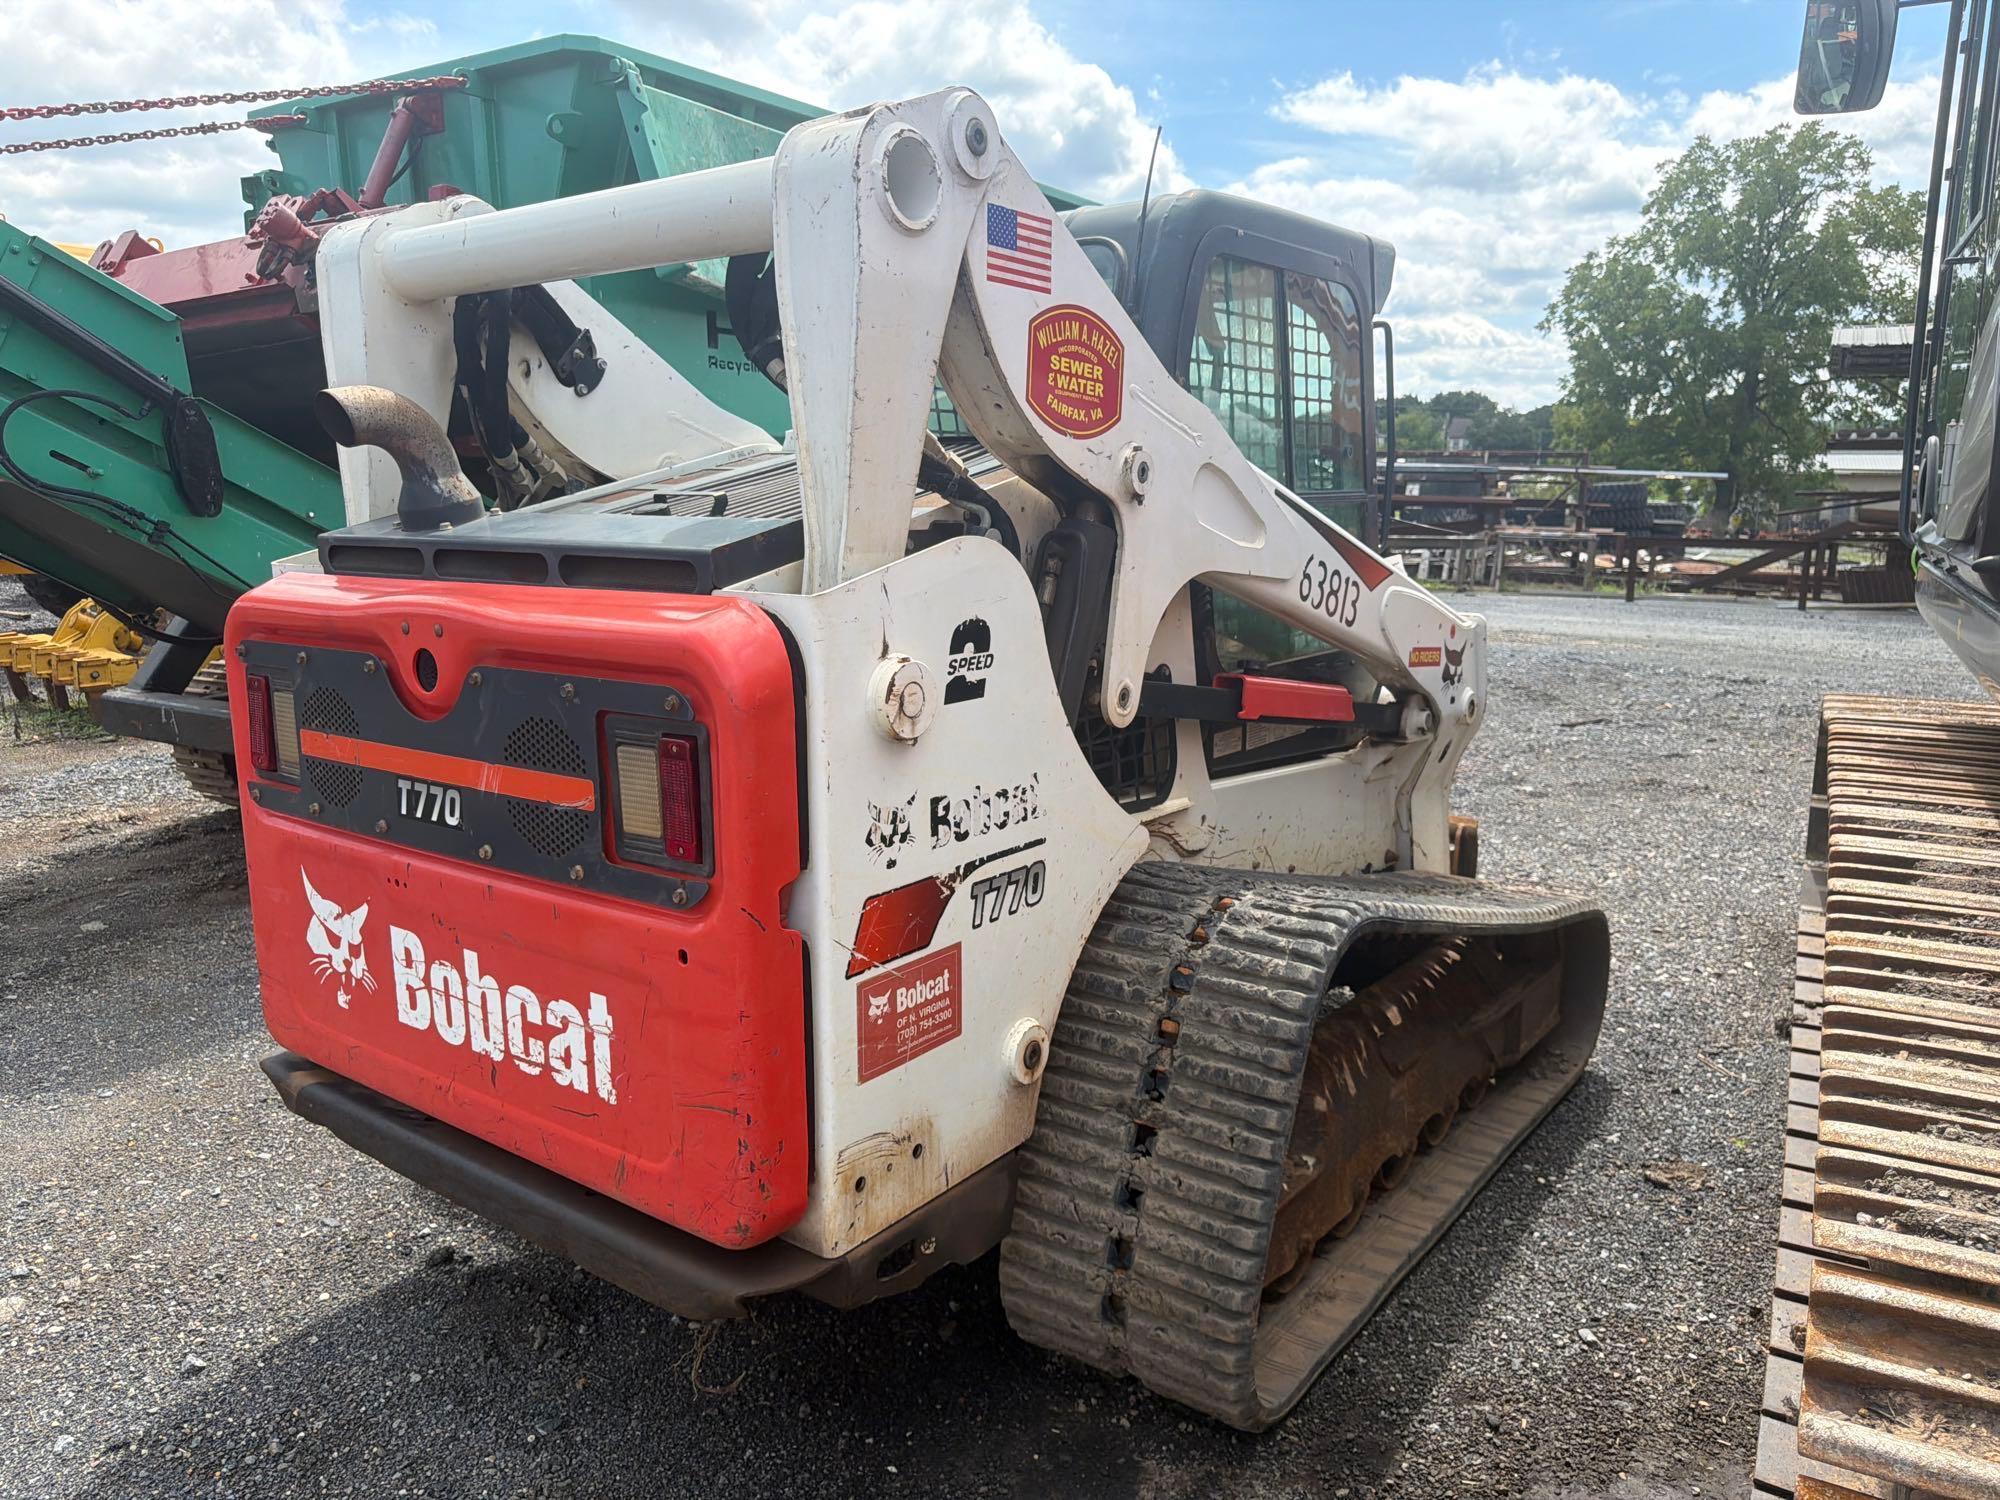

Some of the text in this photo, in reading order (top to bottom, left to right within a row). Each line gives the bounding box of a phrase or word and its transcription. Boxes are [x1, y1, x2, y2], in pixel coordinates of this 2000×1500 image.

[1036, 320, 1119, 370] WILLIAM A. HAZEL
[1058, 345, 1098, 363] INCORPORATED
[708, 355, 761, 376] Recycli
[1050, 354, 1104, 381] SEWER
[1047, 371, 1104, 398] & WATER
[1046, 393, 1104, 424] FAIRFAX, VA
[1299, 553, 1360, 628] 63813
[944, 615, 991, 706] 2
[947, 653, 994, 676] SPEED
[1411, 650, 1440, 664] NO RIDERS
[398, 778, 462, 828] T770
[970, 860, 1046, 930] T770
[896, 968, 951, 1014] Bobcat
[389, 924, 618, 1105] Bobcat
[896, 996, 951, 1029] OF N. VIRGINIA
[897, 1024, 917, 1044] (703)
[919, 1007, 953, 1031] 754-3300
